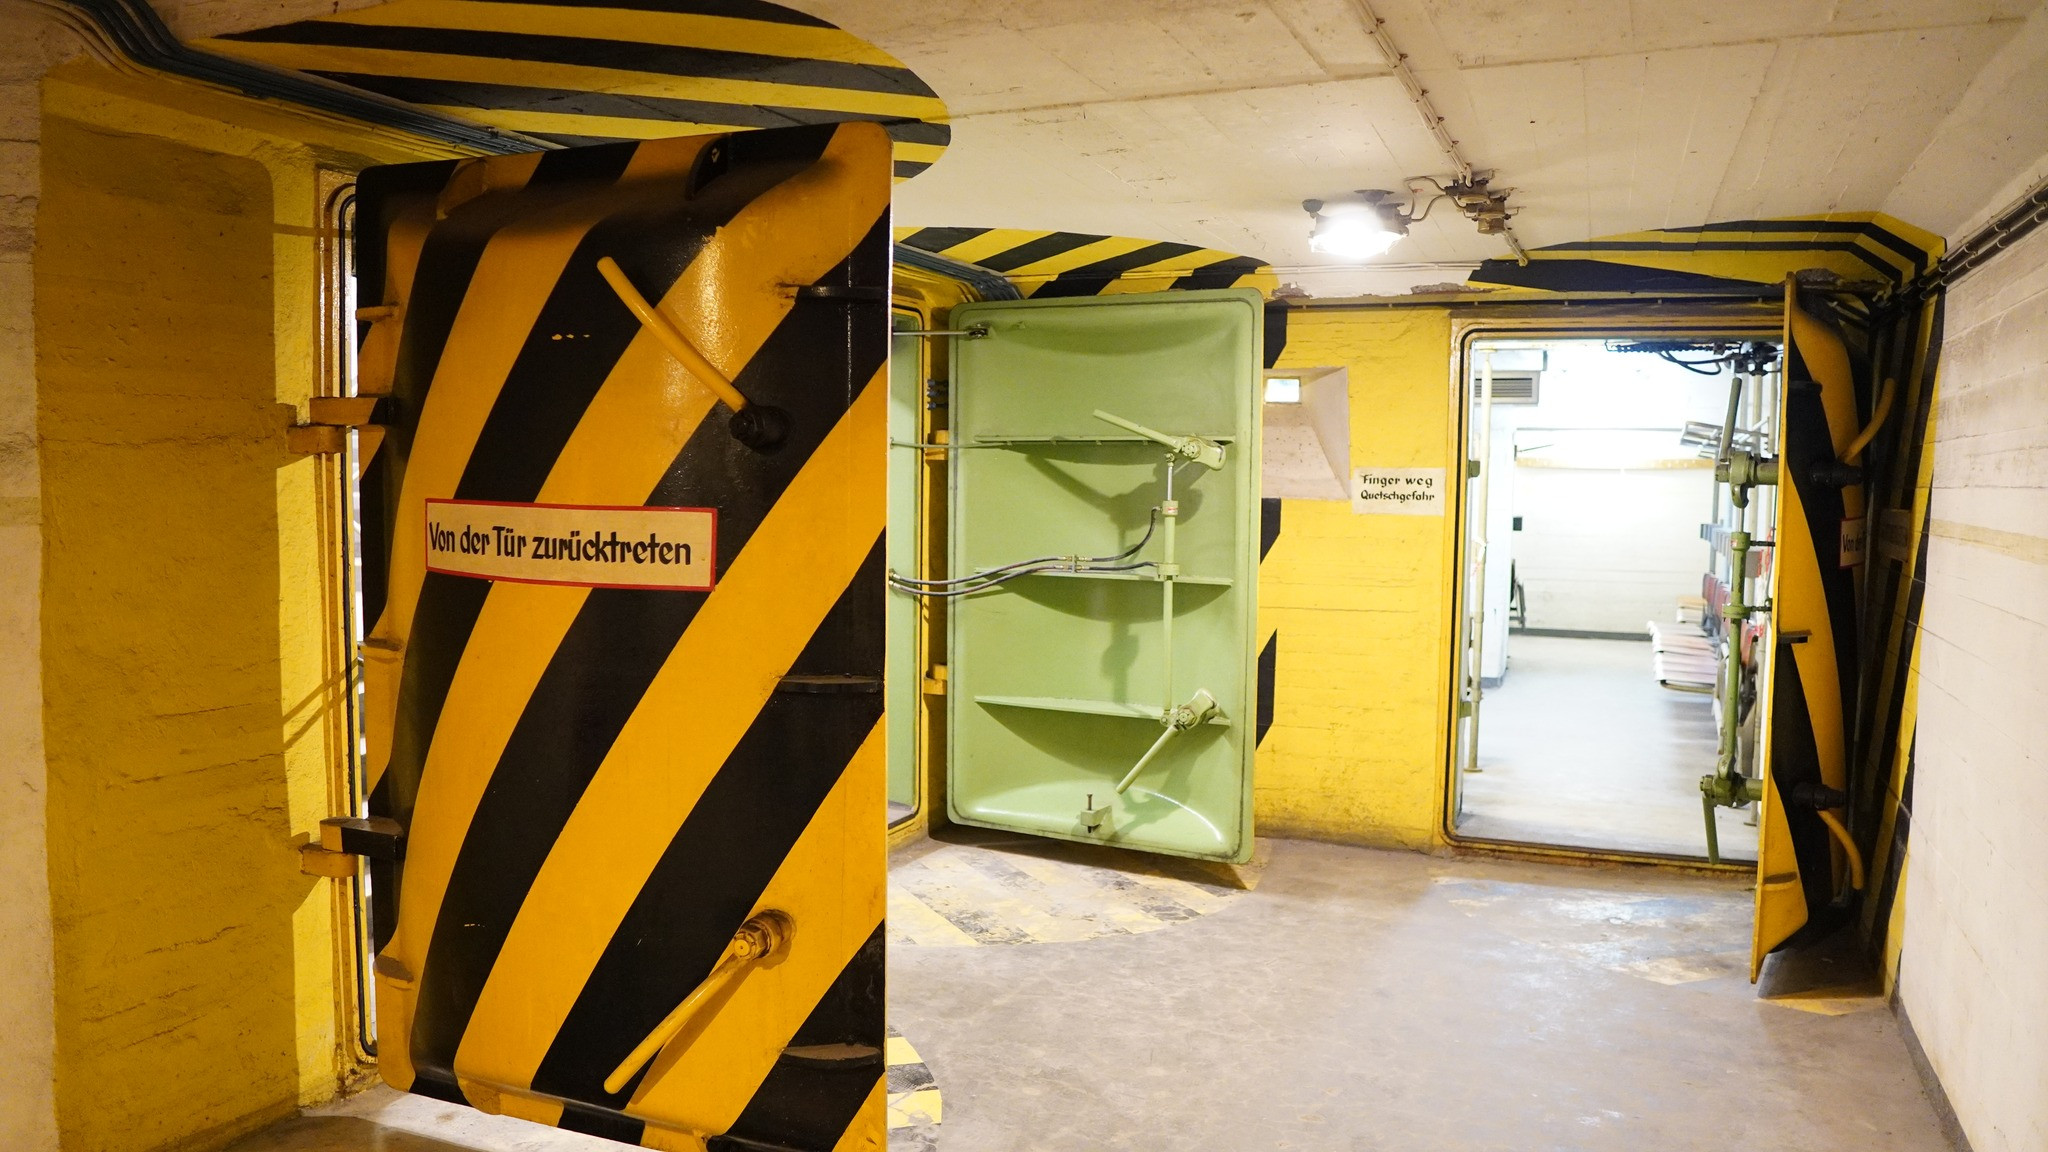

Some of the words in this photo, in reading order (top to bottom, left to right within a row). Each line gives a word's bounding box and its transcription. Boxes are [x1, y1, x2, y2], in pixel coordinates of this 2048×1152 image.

[1360, 474, 1400, 488] Finger
[1405, 477, 1433, 489] weg
[1360, 489, 1435, 504] Quetschgefahr
[429, 521, 456, 553] Von
[459, 524, 490, 556] der
[492, 525, 528, 558] Tür
[531, 530, 692, 565] zurücktreten
